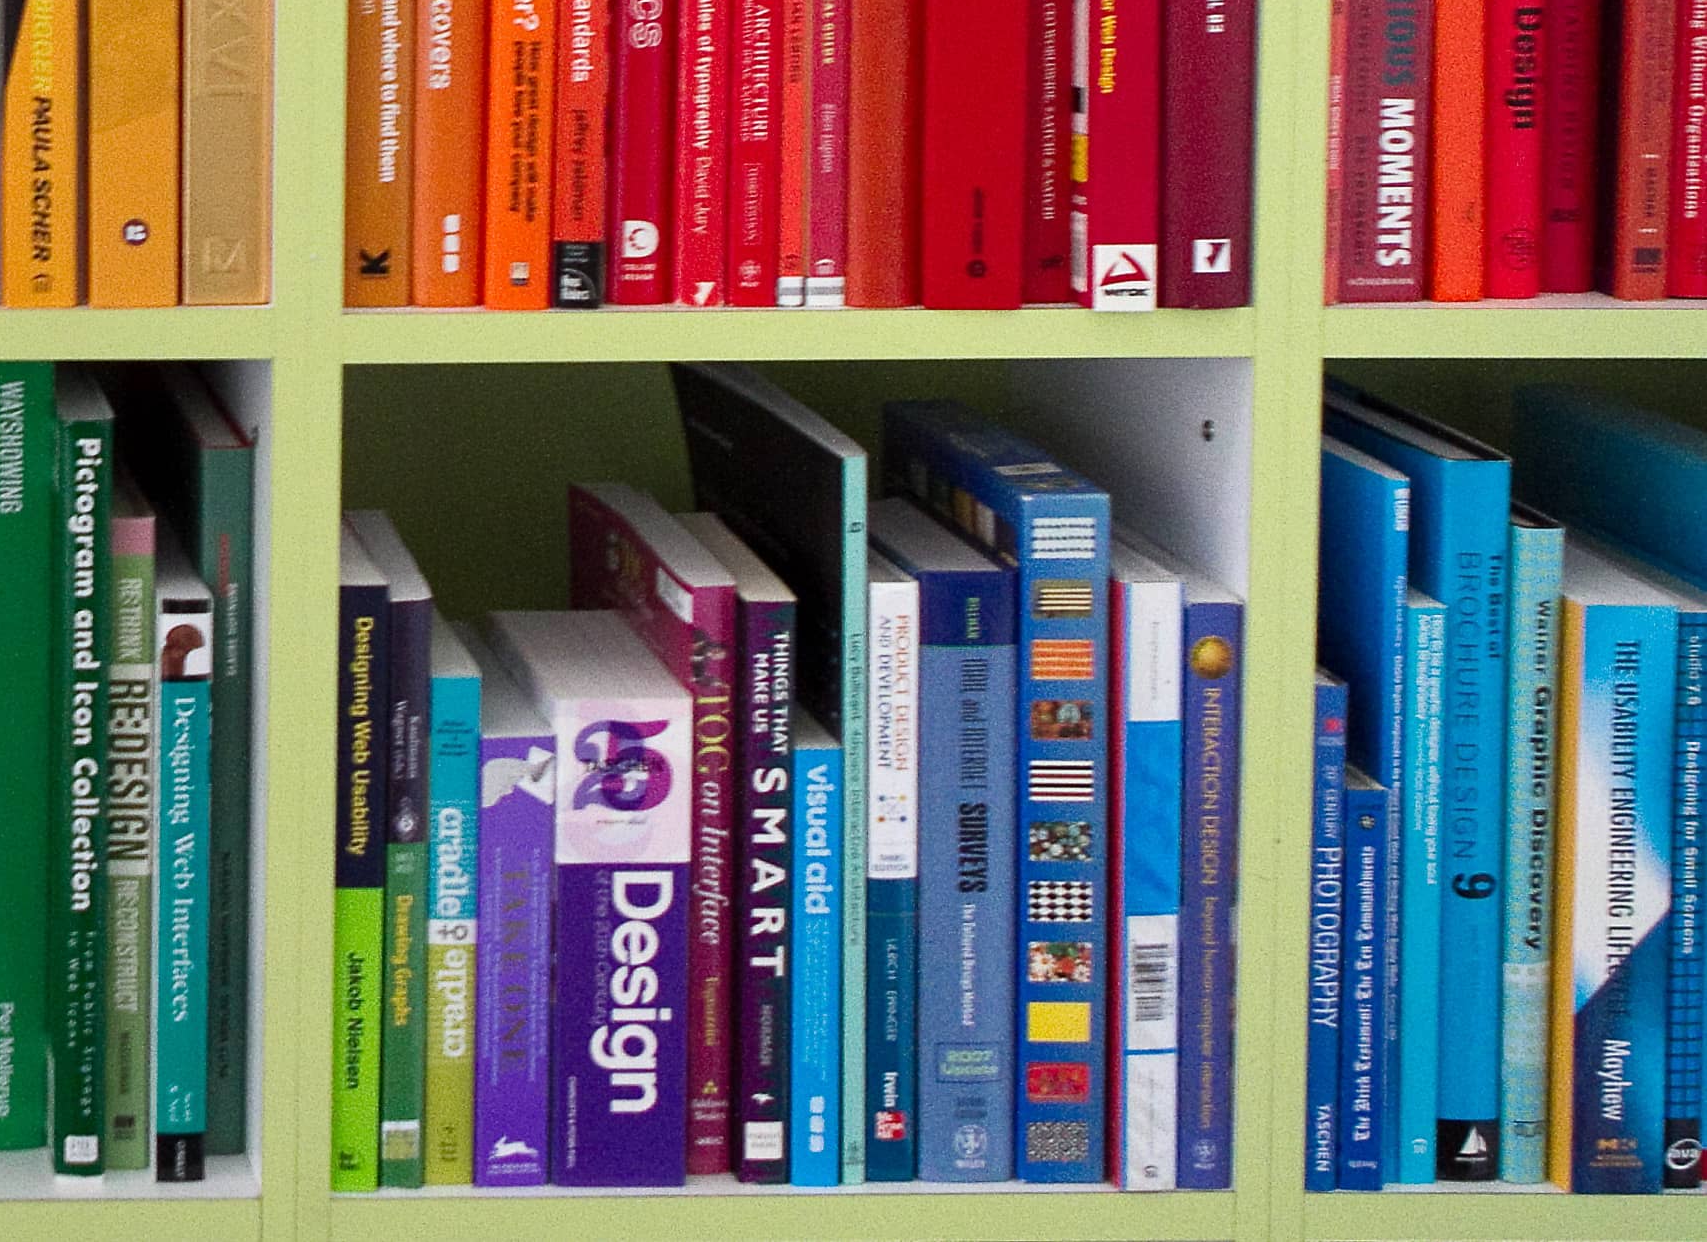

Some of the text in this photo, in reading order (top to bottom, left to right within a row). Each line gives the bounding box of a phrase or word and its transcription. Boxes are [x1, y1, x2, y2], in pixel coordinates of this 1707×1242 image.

[382, 83, 399, 100] to
[383, 29, 400, 80] where
[430, 0, 454, 88] covers
[692, 56, 713, 148] typography
[698, 35, 714, 51] of
[1506, 7, 1543, 130] Design
[32, 97, 52, 261] PAULA SCHER
[380, 141, 399, 182] them
[381, 103, 399, 136] find
[1378, 98, 1414, 266] MOMENTS
[65, 437, 102, 912] Pictogram and Icon Collection
[752, 654, 771, 733] MAKE US
[769, 632, 789, 756] THINGS THAT
[804, 764, 832, 914] visual aid
[1524, 686, 1552, 950] Graphic Discovery
[1607, 641, 1640, 916] THE USABILITY ENGINEERING
[169, 697, 198, 1022] Designing Web Interfaces
[345, 617, 373, 1088] Designing Web Usability Jakob Nielsen
[750, 768, 787, 977] SMART
[957, 803, 988, 893] SURVEYS
[590, 871, 671, 1112] Design
[1313, 848, 1341, 1027] PHOTOGRAPHY
[1598, 1039, 1632, 1121] Mayhew
